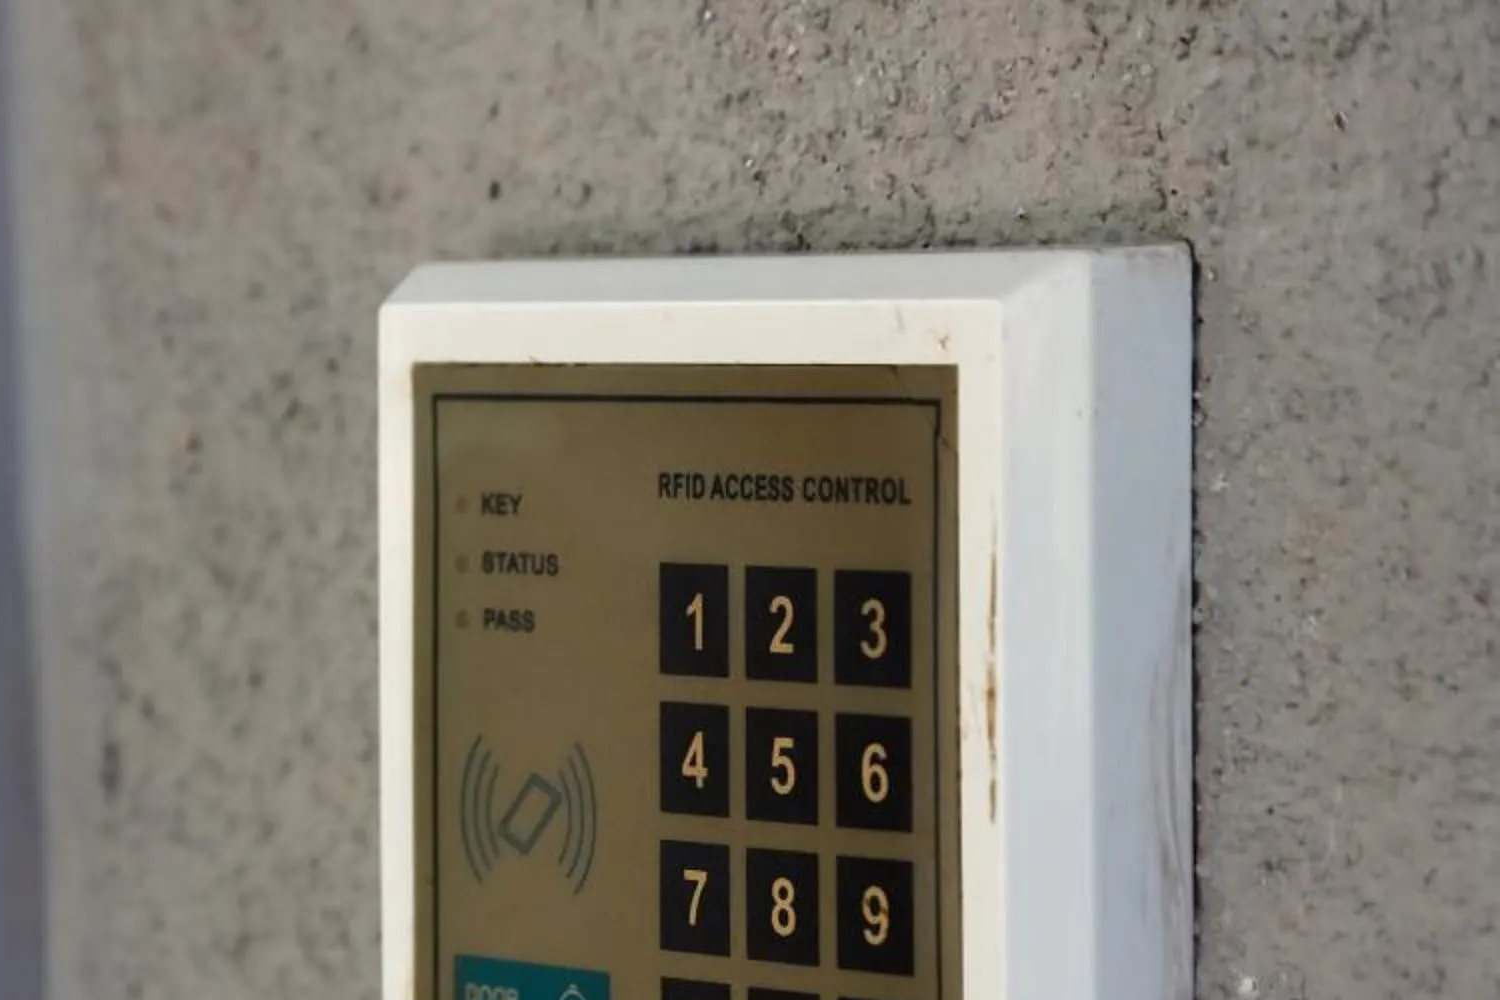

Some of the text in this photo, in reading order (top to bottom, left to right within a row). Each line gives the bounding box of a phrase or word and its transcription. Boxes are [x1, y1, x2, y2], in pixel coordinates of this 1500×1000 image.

[480, 491, 524, 517] KEY
[657, 472, 912, 506] RFID ACCESS CONTROL
[482, 551, 560, 578] STATUS
[483, 607, 536, 633] PASS
[685, 592, 888, 659] 1 2 3
[681, 731, 889, 804] 4 5 6
[683, 868, 890, 946] 7 8 9
